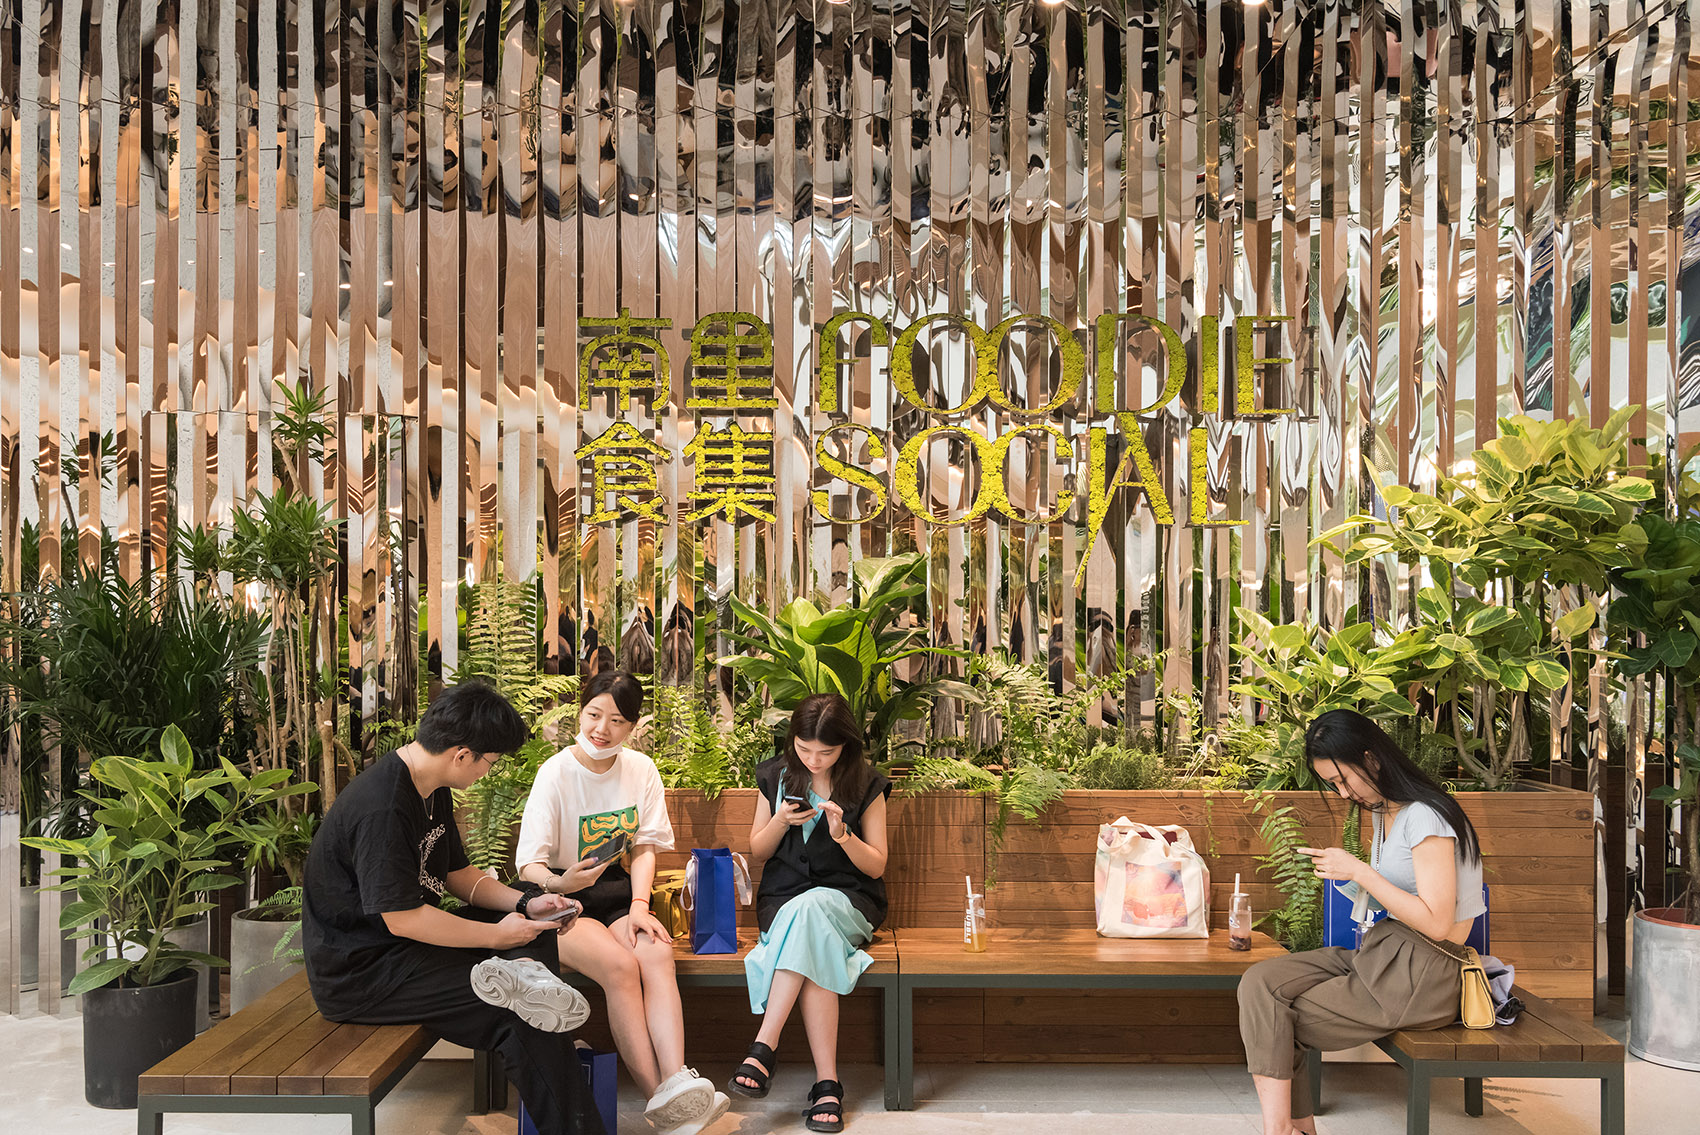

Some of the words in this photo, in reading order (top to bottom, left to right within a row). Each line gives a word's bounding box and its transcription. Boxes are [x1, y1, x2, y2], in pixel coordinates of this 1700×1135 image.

[578, 307, 778, 411] 南里
[819, 313, 1295, 414] FOODIE
[574, 421, 777, 525] 食集
[812, 412, 1250, 587] SOCIAL
